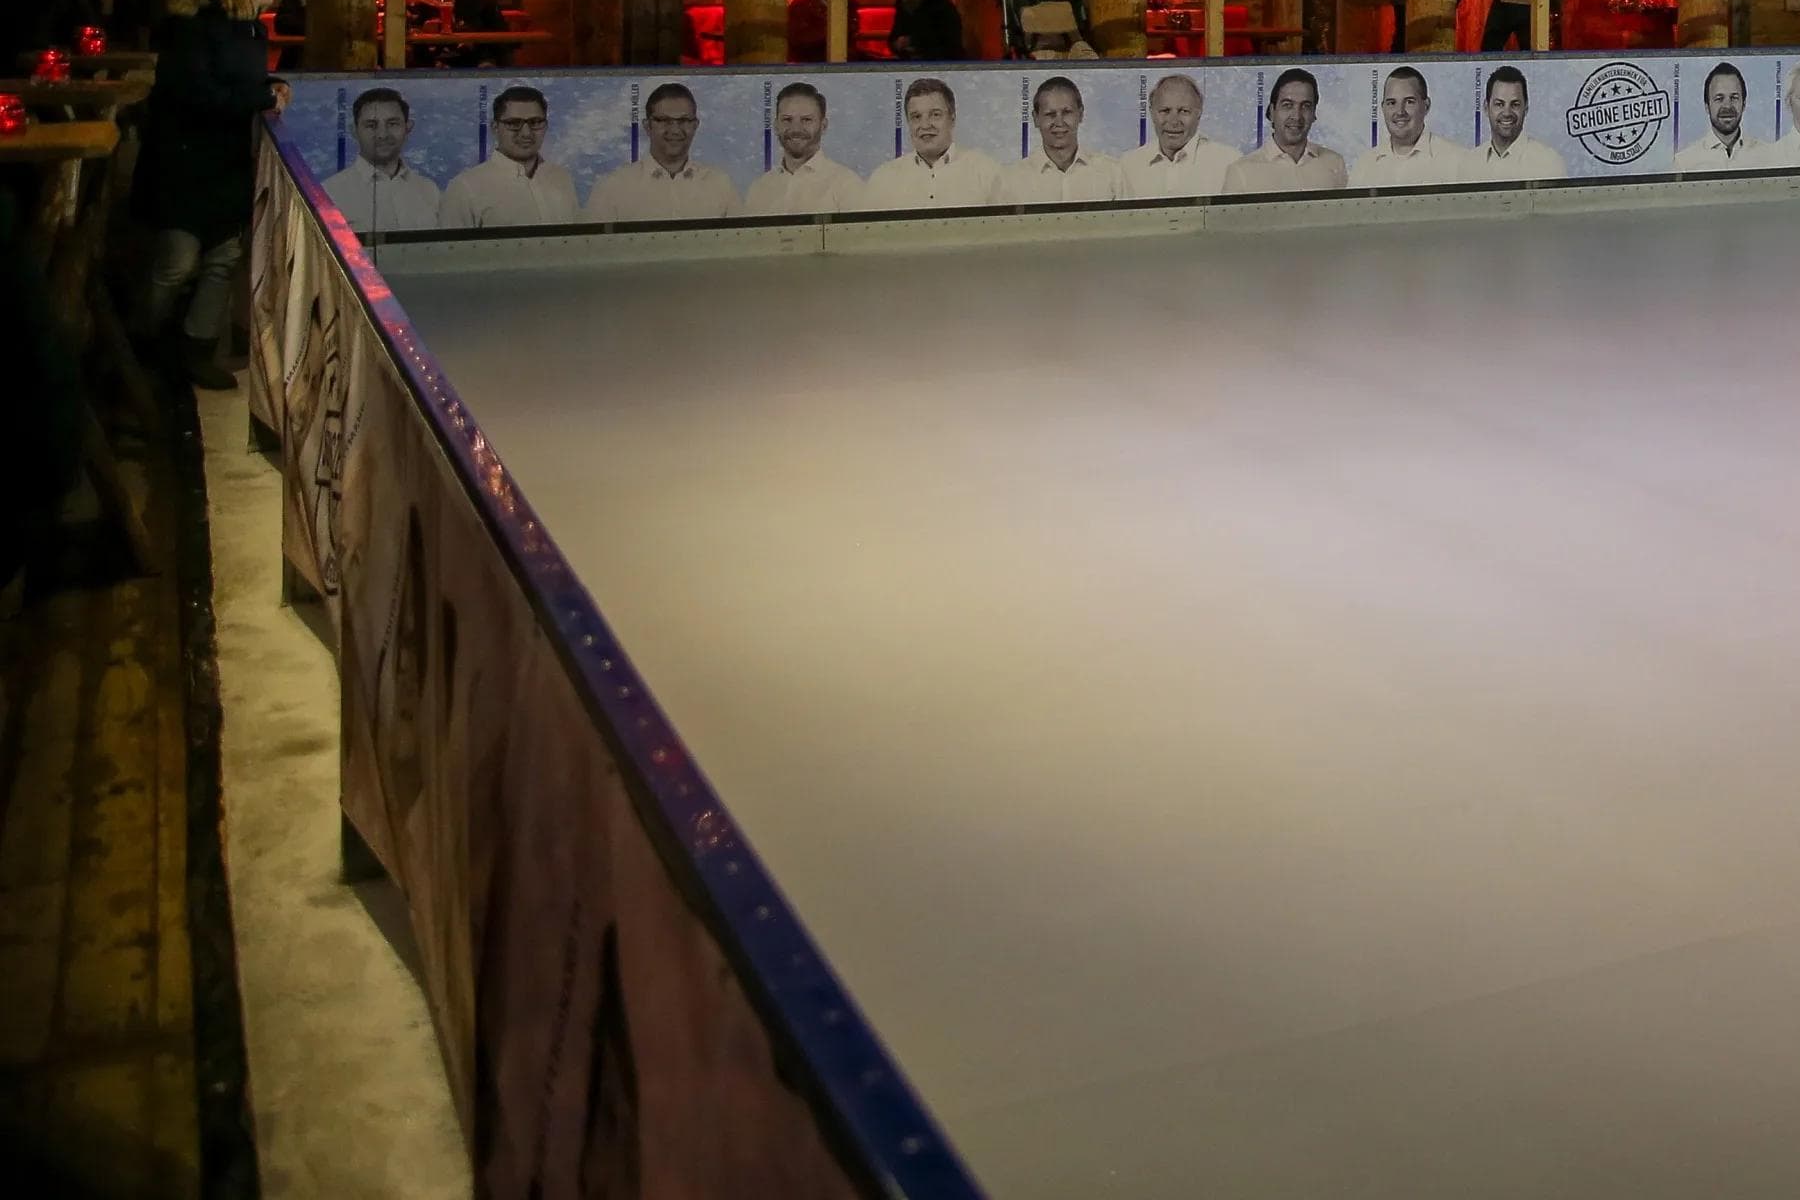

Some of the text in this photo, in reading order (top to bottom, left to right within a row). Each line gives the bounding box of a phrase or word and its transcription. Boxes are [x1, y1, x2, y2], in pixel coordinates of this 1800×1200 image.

[1572, 98, 1664, 129] SCHÖNE EISZEIT
[1609, 143, 1642, 160] INGOLSTADT
